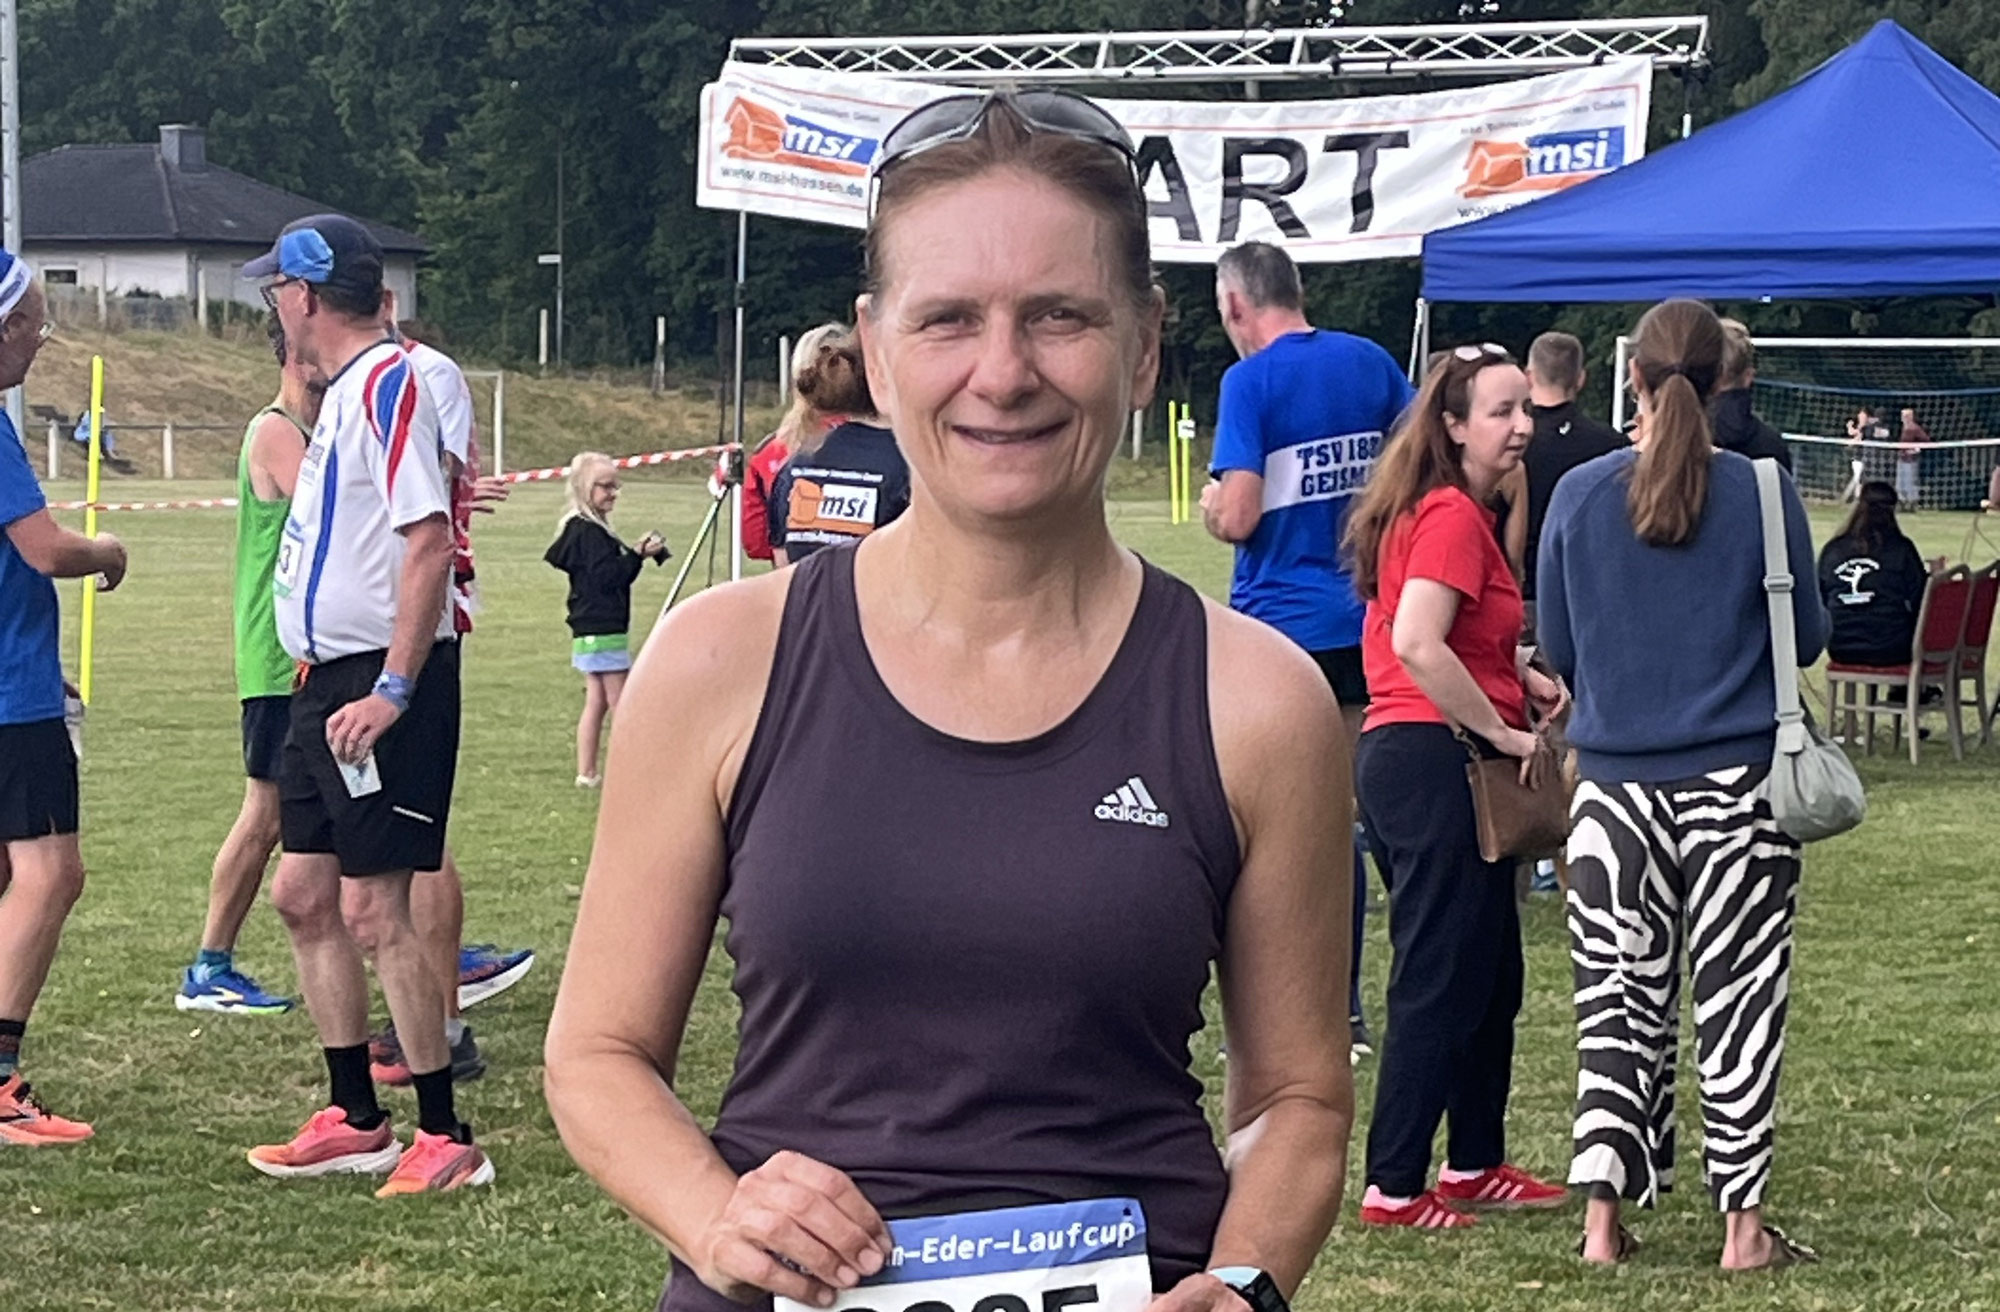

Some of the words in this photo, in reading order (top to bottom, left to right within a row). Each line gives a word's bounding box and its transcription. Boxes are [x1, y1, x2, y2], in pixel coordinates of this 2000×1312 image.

[784, 126, 862, 159] msi
[1527, 130, 1610, 175] msi
[1135, 131, 1410, 243] ART
[1296, 440, 1343, 470] TSV
[1301, 466, 1372, 497] GEISM
[820, 491, 869, 519] msi
[1094, 804, 1170, 828] adidas
[885, 1221, 1136, 1268] n-Eder-Laufcup
